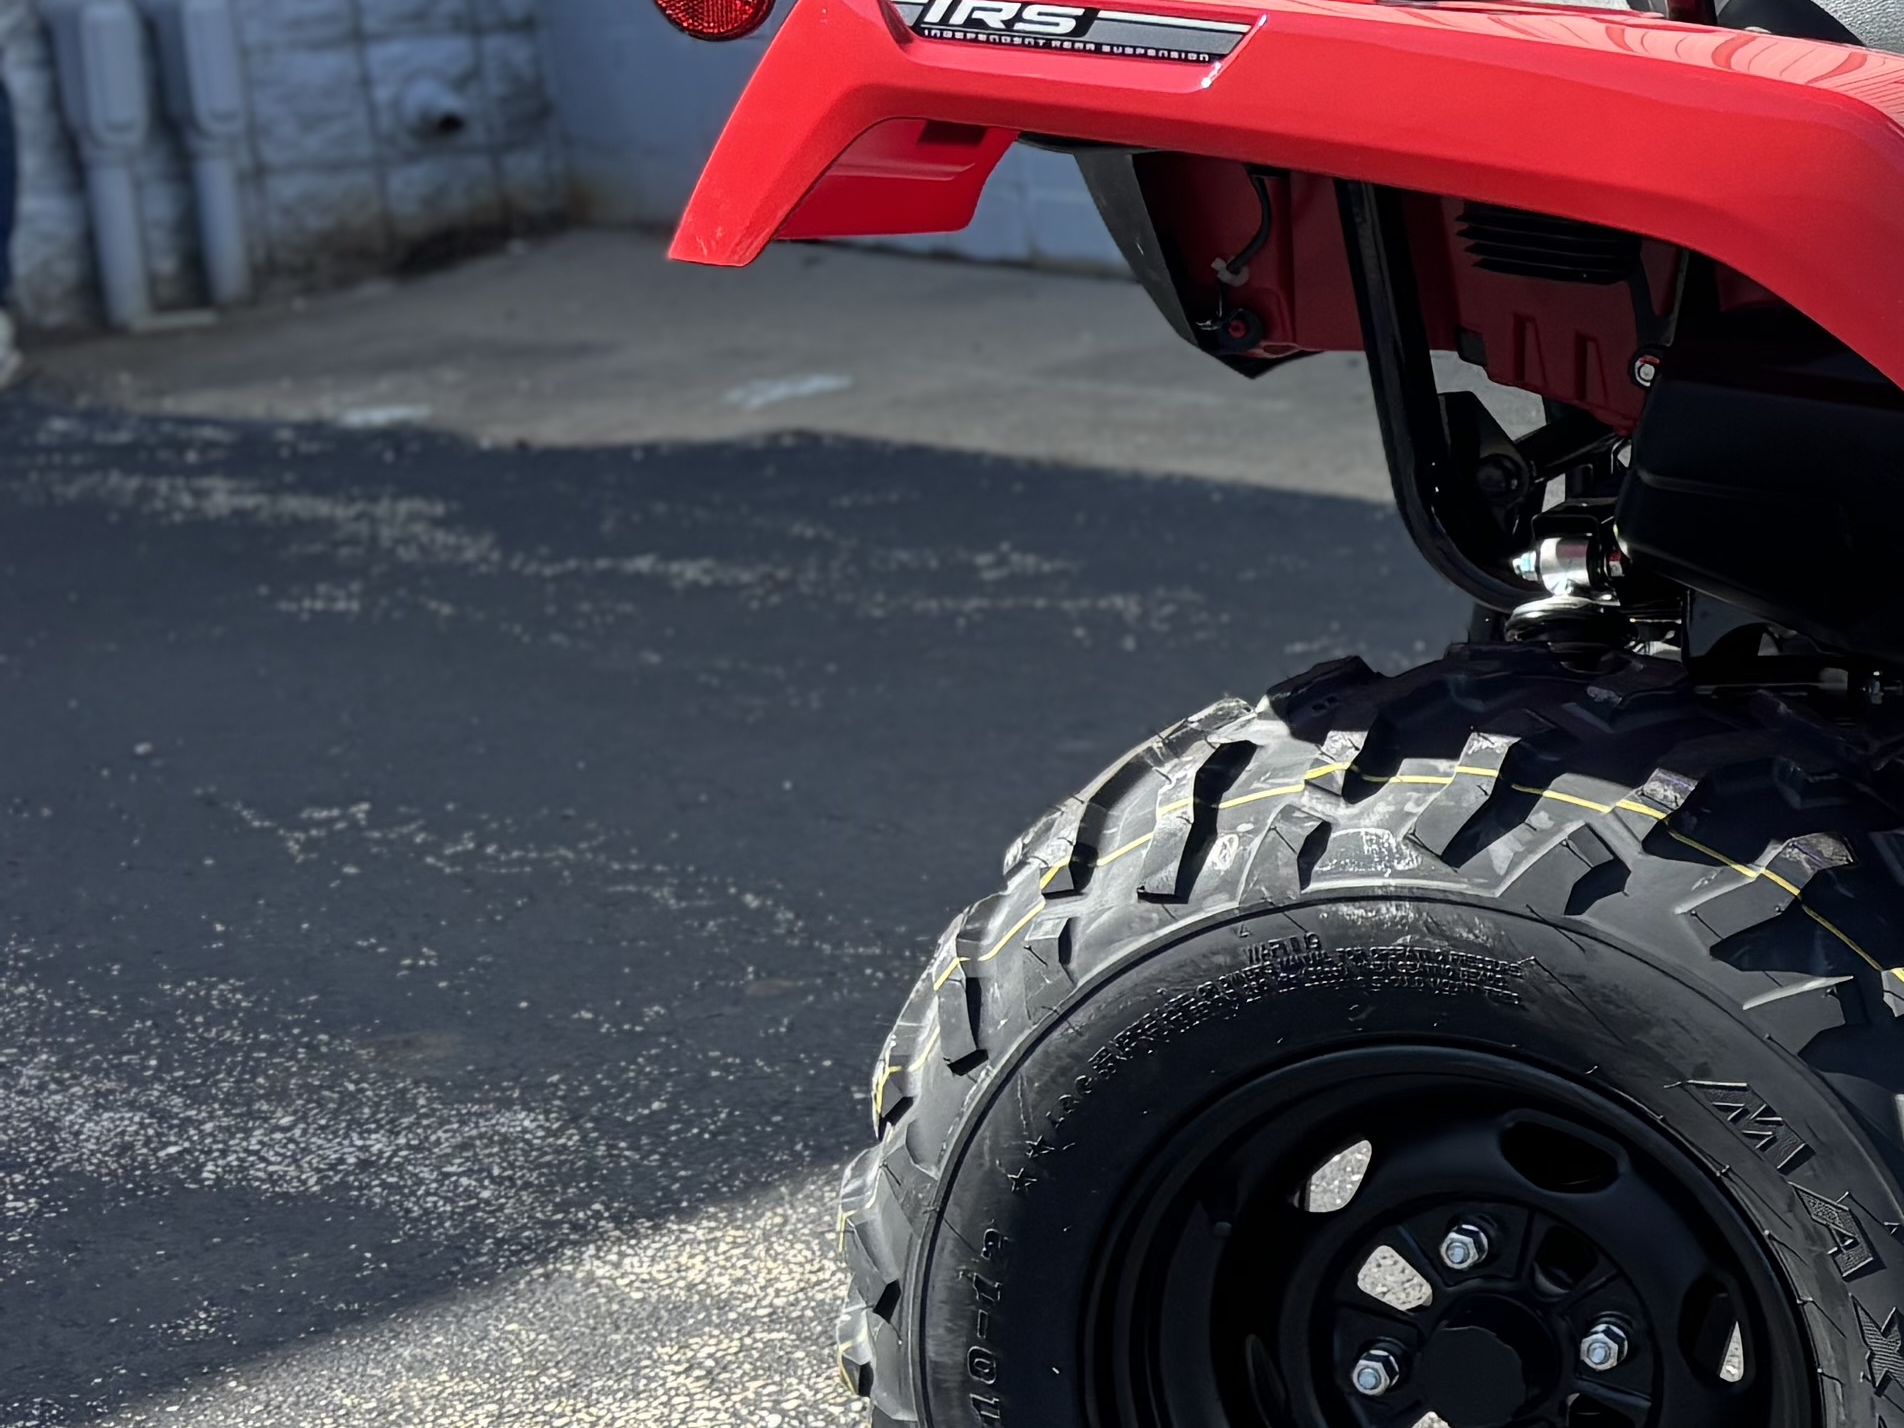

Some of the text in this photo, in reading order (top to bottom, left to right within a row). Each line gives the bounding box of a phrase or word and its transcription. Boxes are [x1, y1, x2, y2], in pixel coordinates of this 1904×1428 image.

[924, 28, 1210, 62] INDEPENDENT REAR SUSPENSION
